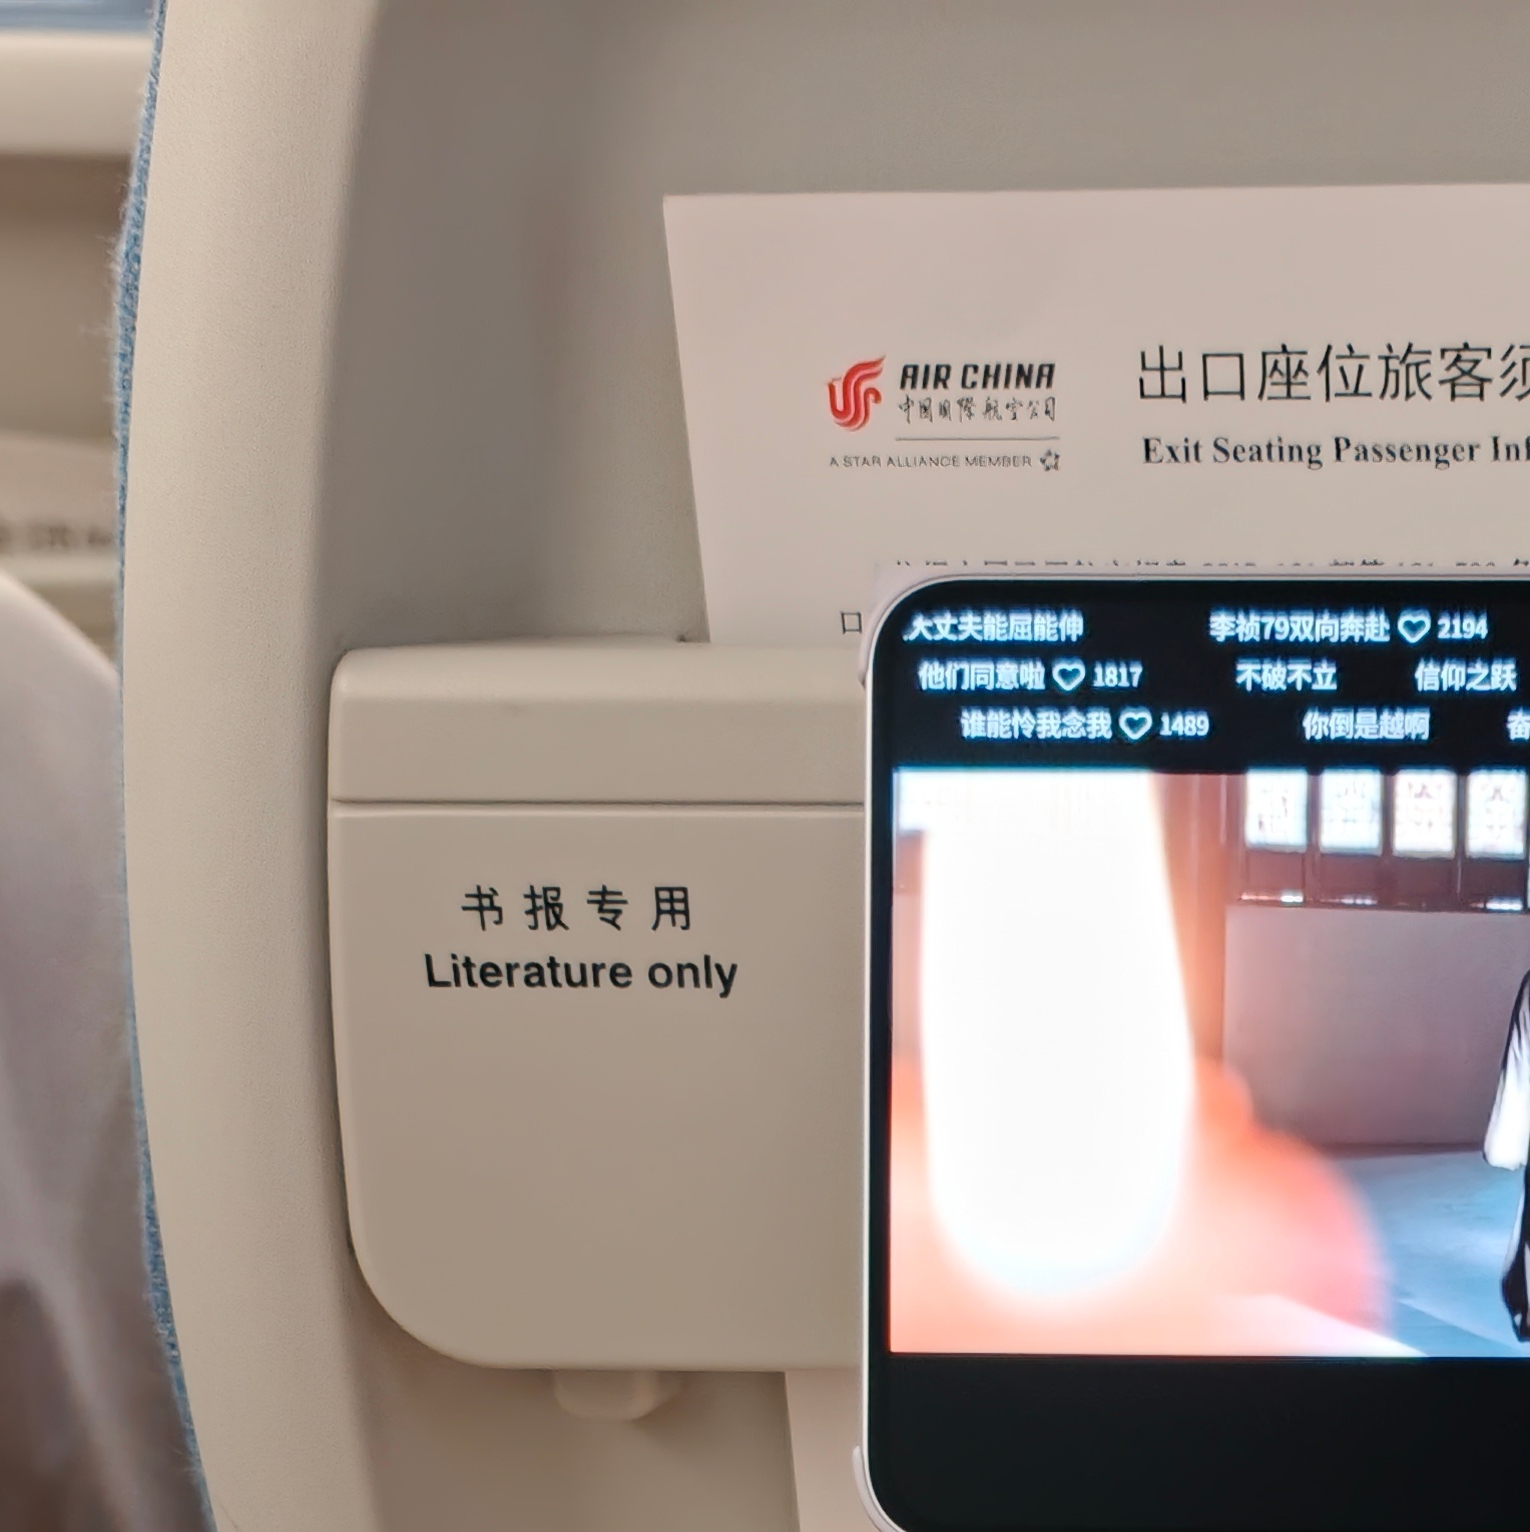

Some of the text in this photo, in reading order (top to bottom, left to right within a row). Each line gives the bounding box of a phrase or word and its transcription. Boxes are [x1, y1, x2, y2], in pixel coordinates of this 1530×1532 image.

[899, 363, 1057, 391] AIR CHINA
[829, 455, 1033, 468] A STAR ALLIANCE MEMBER
[1142, 435, 1203, 465] Exit
[1212, 435, 1324, 470] Seating
[1333, 436, 1481, 471] Passenger
[1437, 610, 1489, 640] 2194
[918, 657, 1143, 691] 他们同意啦 1817
[1235, 656, 1338, 691] 不破不立
[1414, 656, 1518, 691] 信仰之跃
[1158, 711, 1210, 738] 1489
[1302, 706, 1431, 741] 你倒是越啊
[461, 884, 692, 932] 书报专用
[424, 953, 738, 999] Literature only
